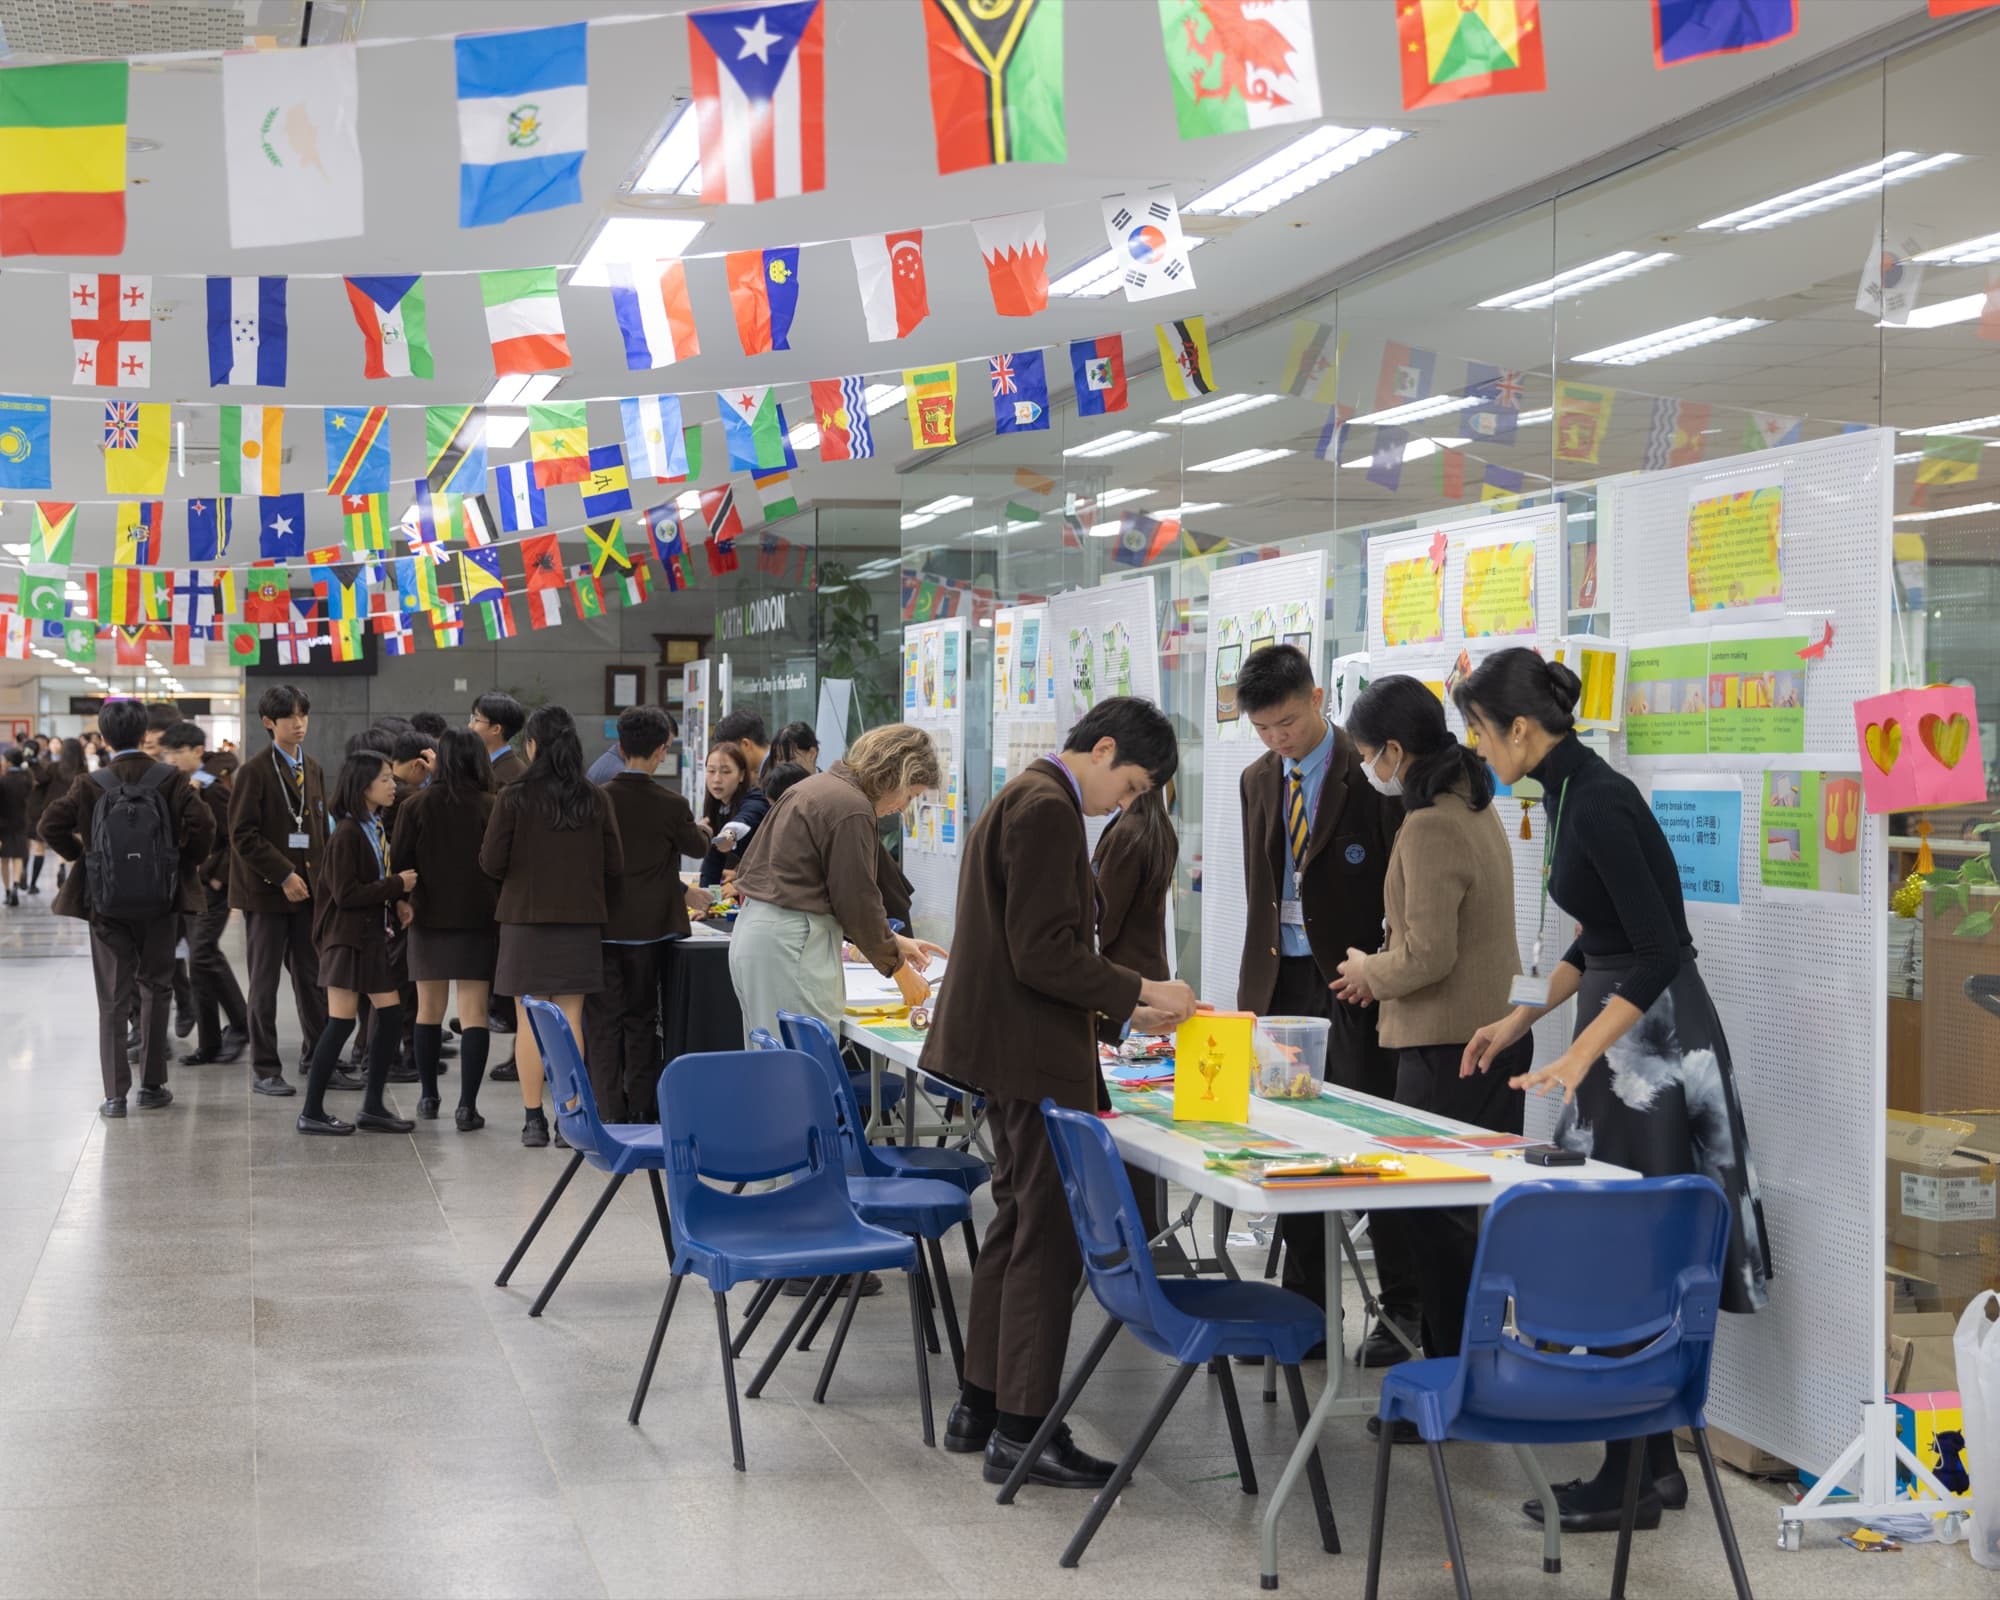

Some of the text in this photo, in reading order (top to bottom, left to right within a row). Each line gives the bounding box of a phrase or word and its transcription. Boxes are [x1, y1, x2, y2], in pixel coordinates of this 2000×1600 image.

[715, 594, 785, 640] NORTH LONDON
[786, 672, 807, 690] School's
[1655, 801, 1696, 811] Every break time
[1670, 817, 1690, 829] painting
[1676, 833, 1690, 843] sticks
[1683, 864, 1695, 874] time
[1681, 881, 1697, 892] aking
